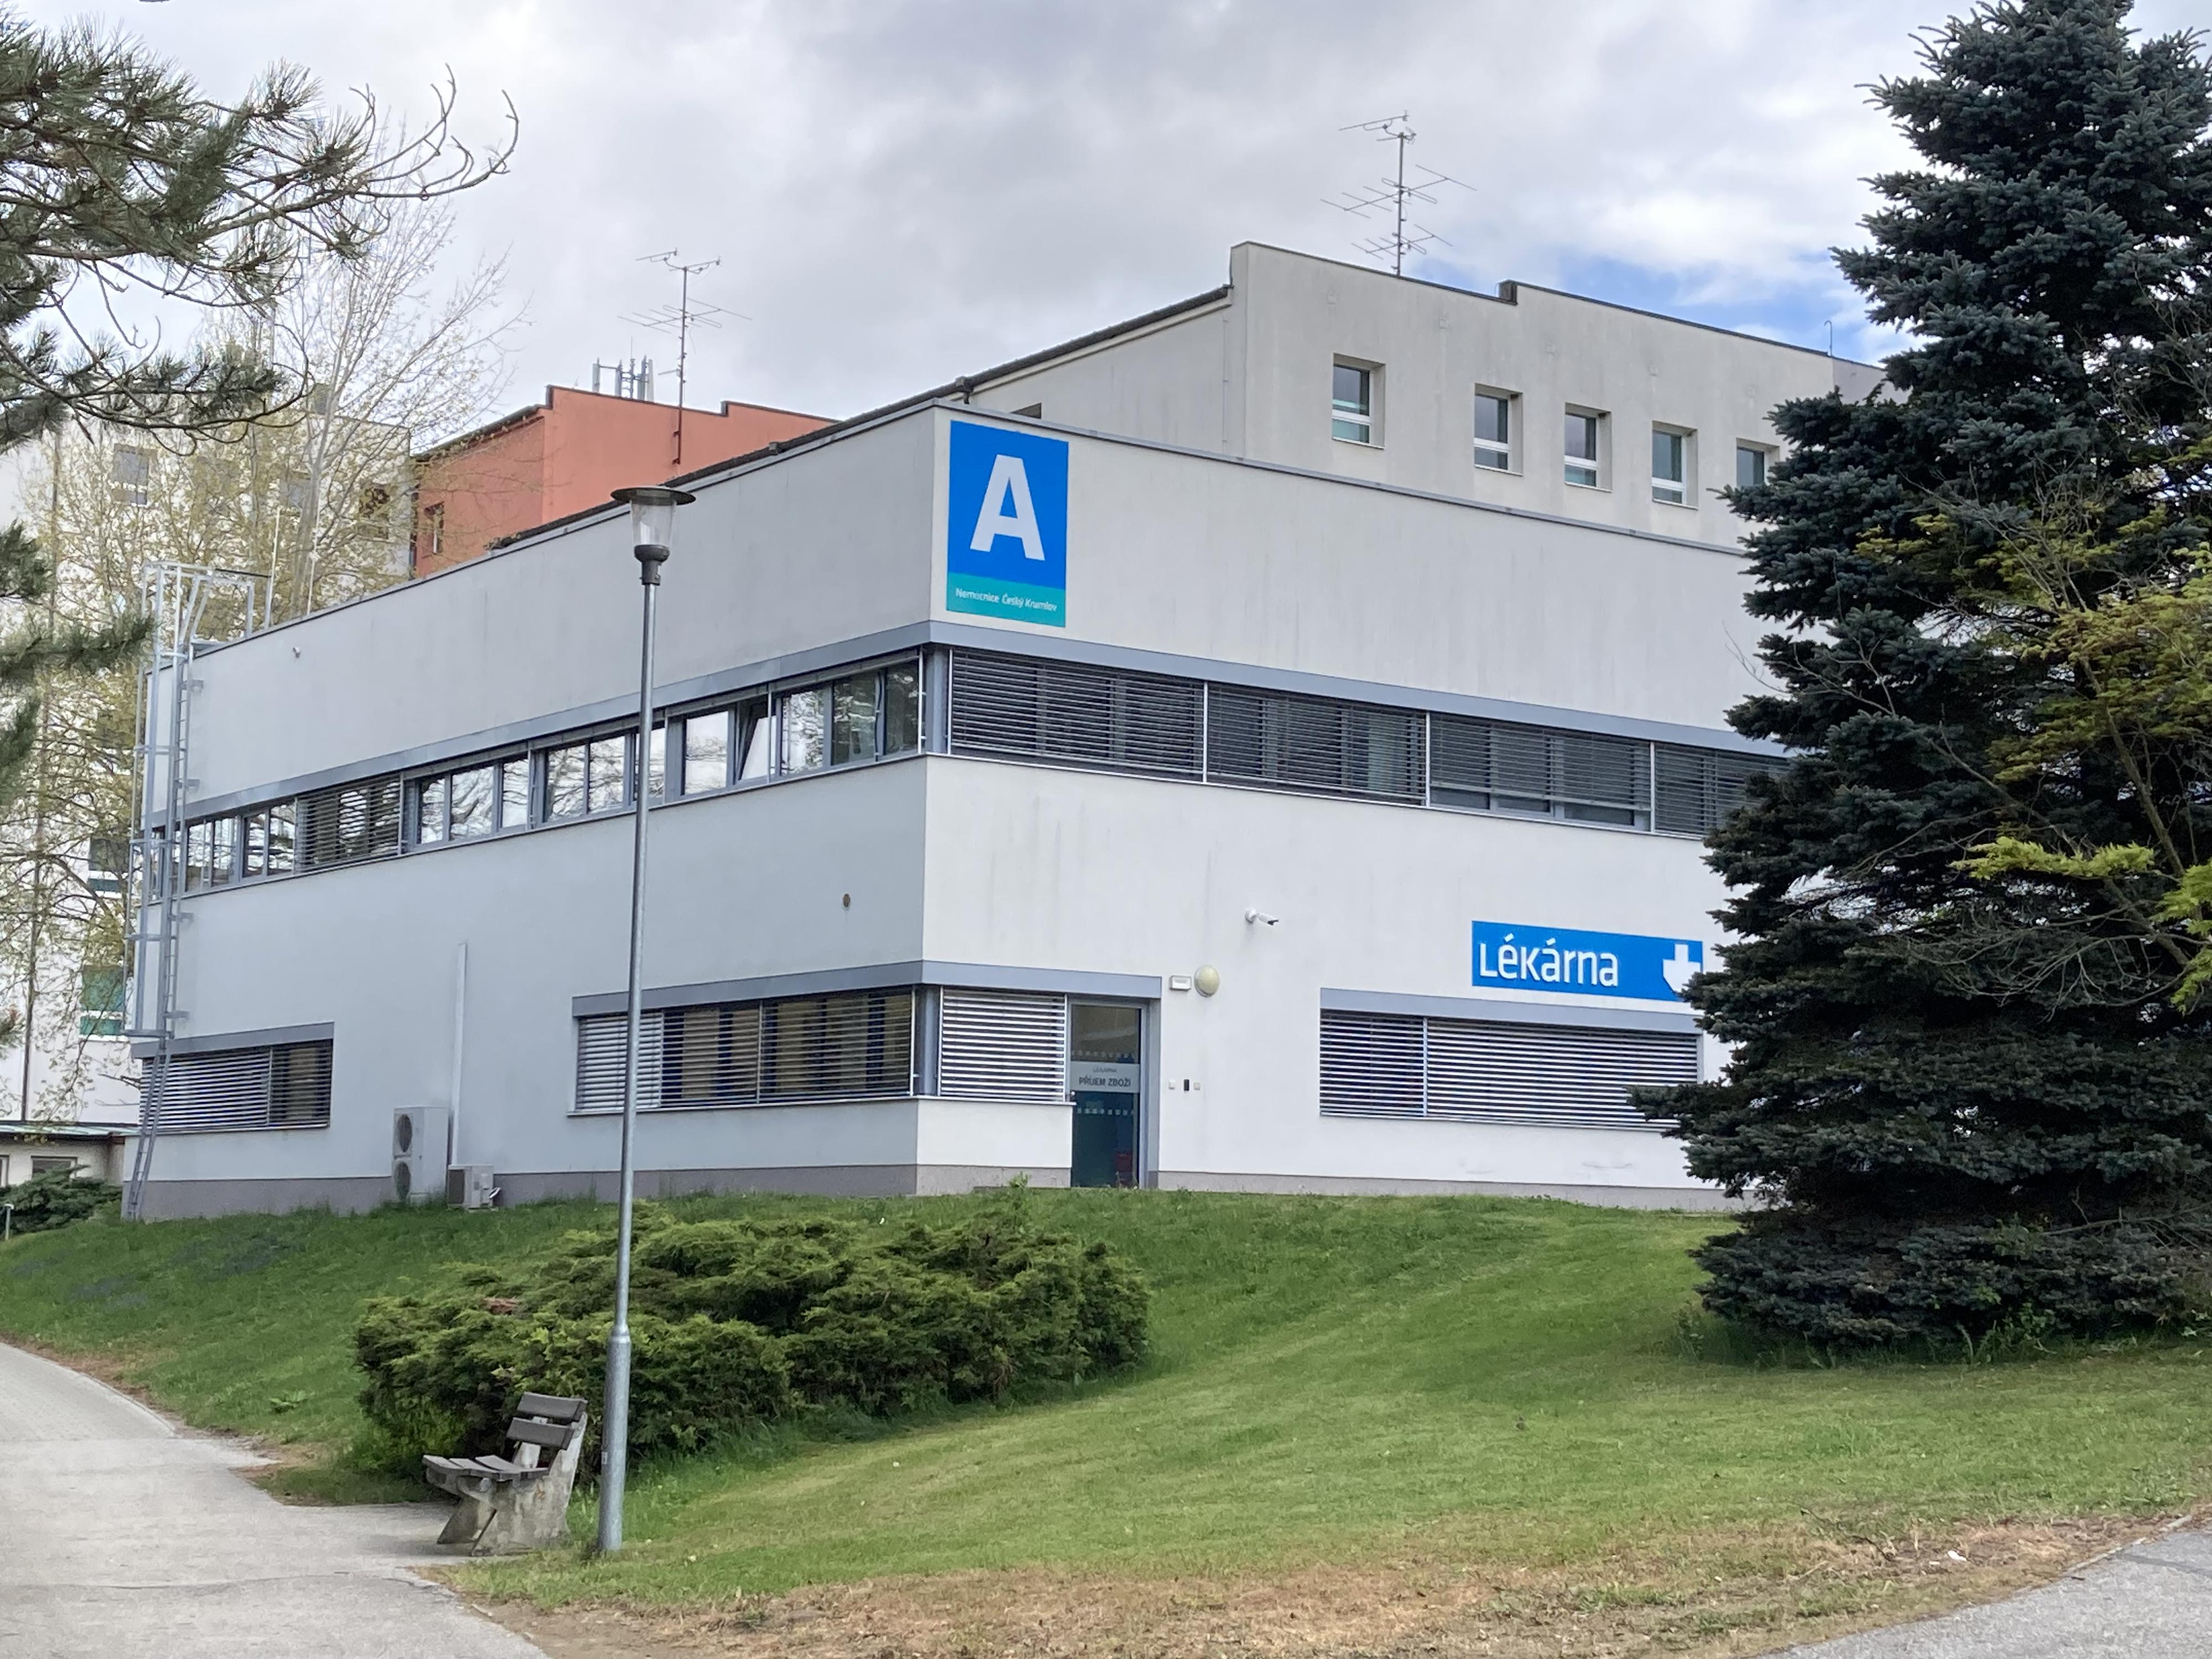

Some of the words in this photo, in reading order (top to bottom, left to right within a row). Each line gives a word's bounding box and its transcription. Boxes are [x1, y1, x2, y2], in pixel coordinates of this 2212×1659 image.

[970, 454, 1045, 561] A
[955, 587, 999, 603] Nemocnice
[1001, 593, 1024, 608] Český
[1025, 598, 1057, 612] Krumlov
[1479, 933, 1618, 987] Lékárna
